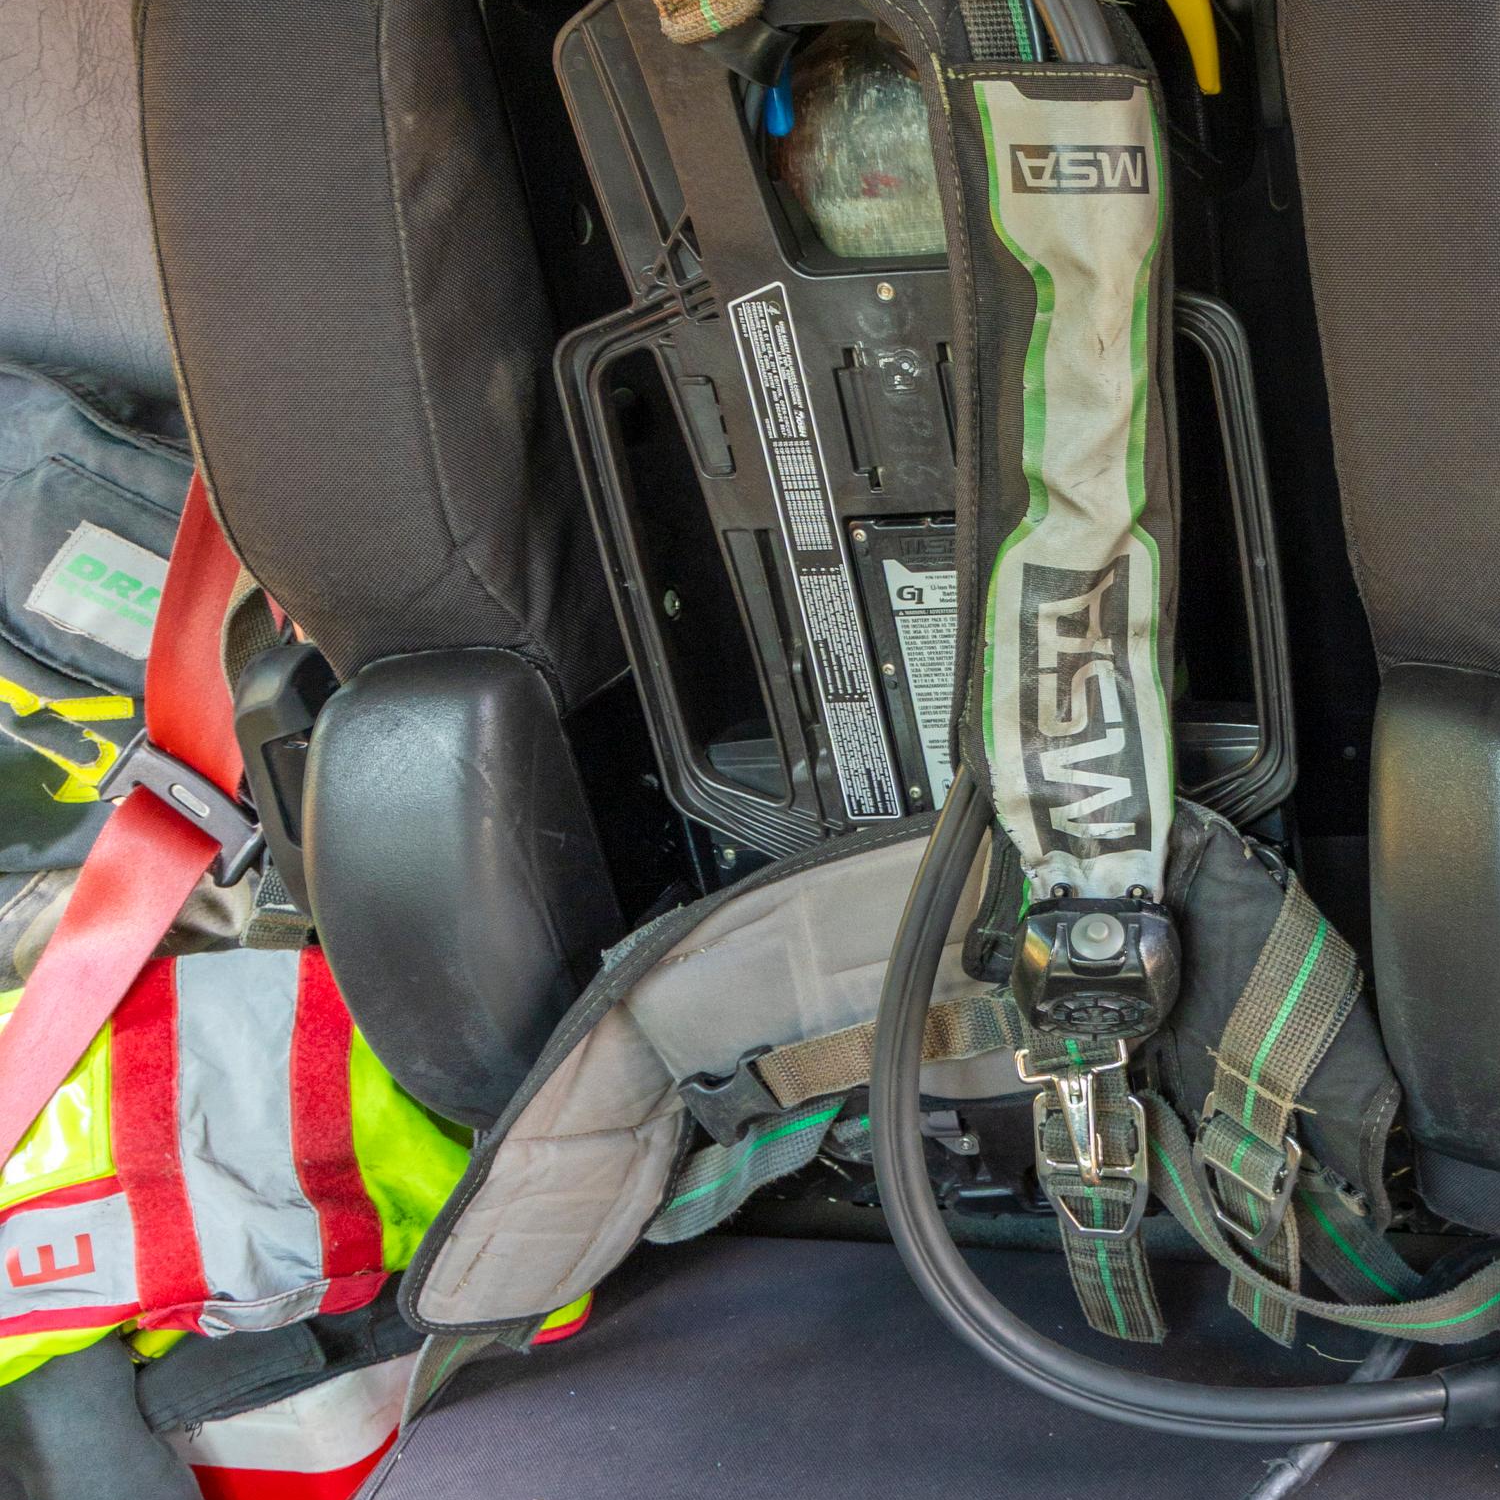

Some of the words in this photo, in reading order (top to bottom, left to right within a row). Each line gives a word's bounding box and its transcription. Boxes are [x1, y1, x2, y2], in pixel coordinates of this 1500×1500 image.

[1015, 150, 1143, 187] MSA
[896, 585, 925, 605] G1
[1038, 569, 1135, 839] MSA
